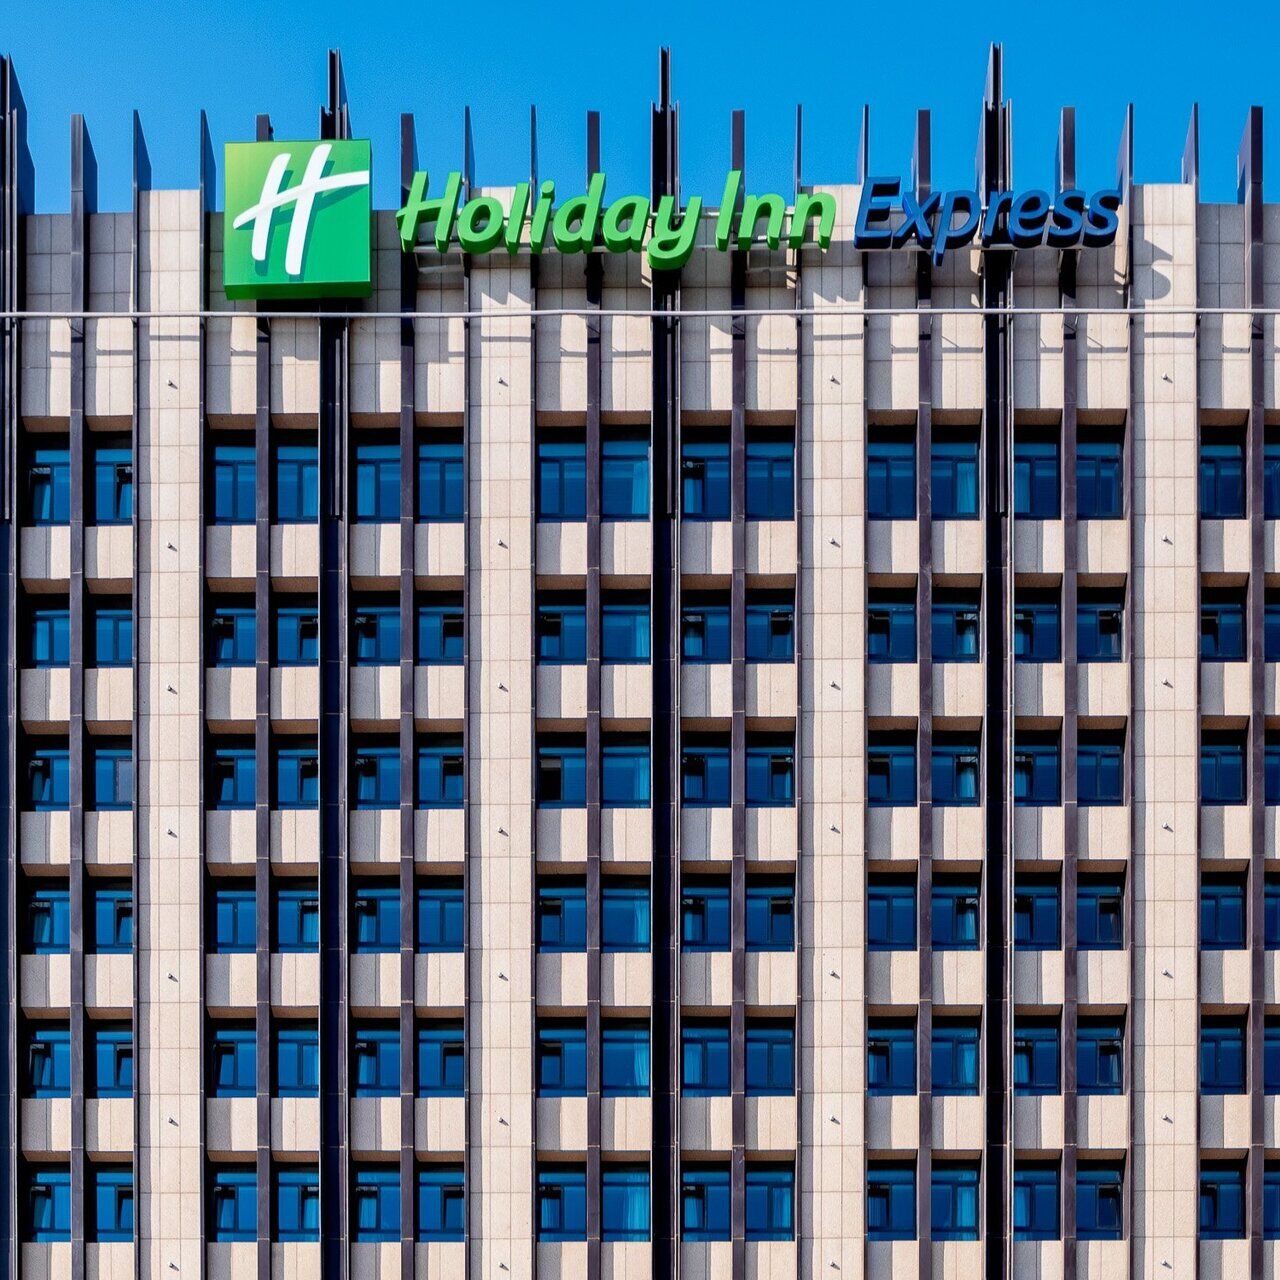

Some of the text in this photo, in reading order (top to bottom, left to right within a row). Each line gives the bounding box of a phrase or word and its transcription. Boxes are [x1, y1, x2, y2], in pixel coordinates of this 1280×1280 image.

[395, 168, 1122, 270] Holiday Inn Express
